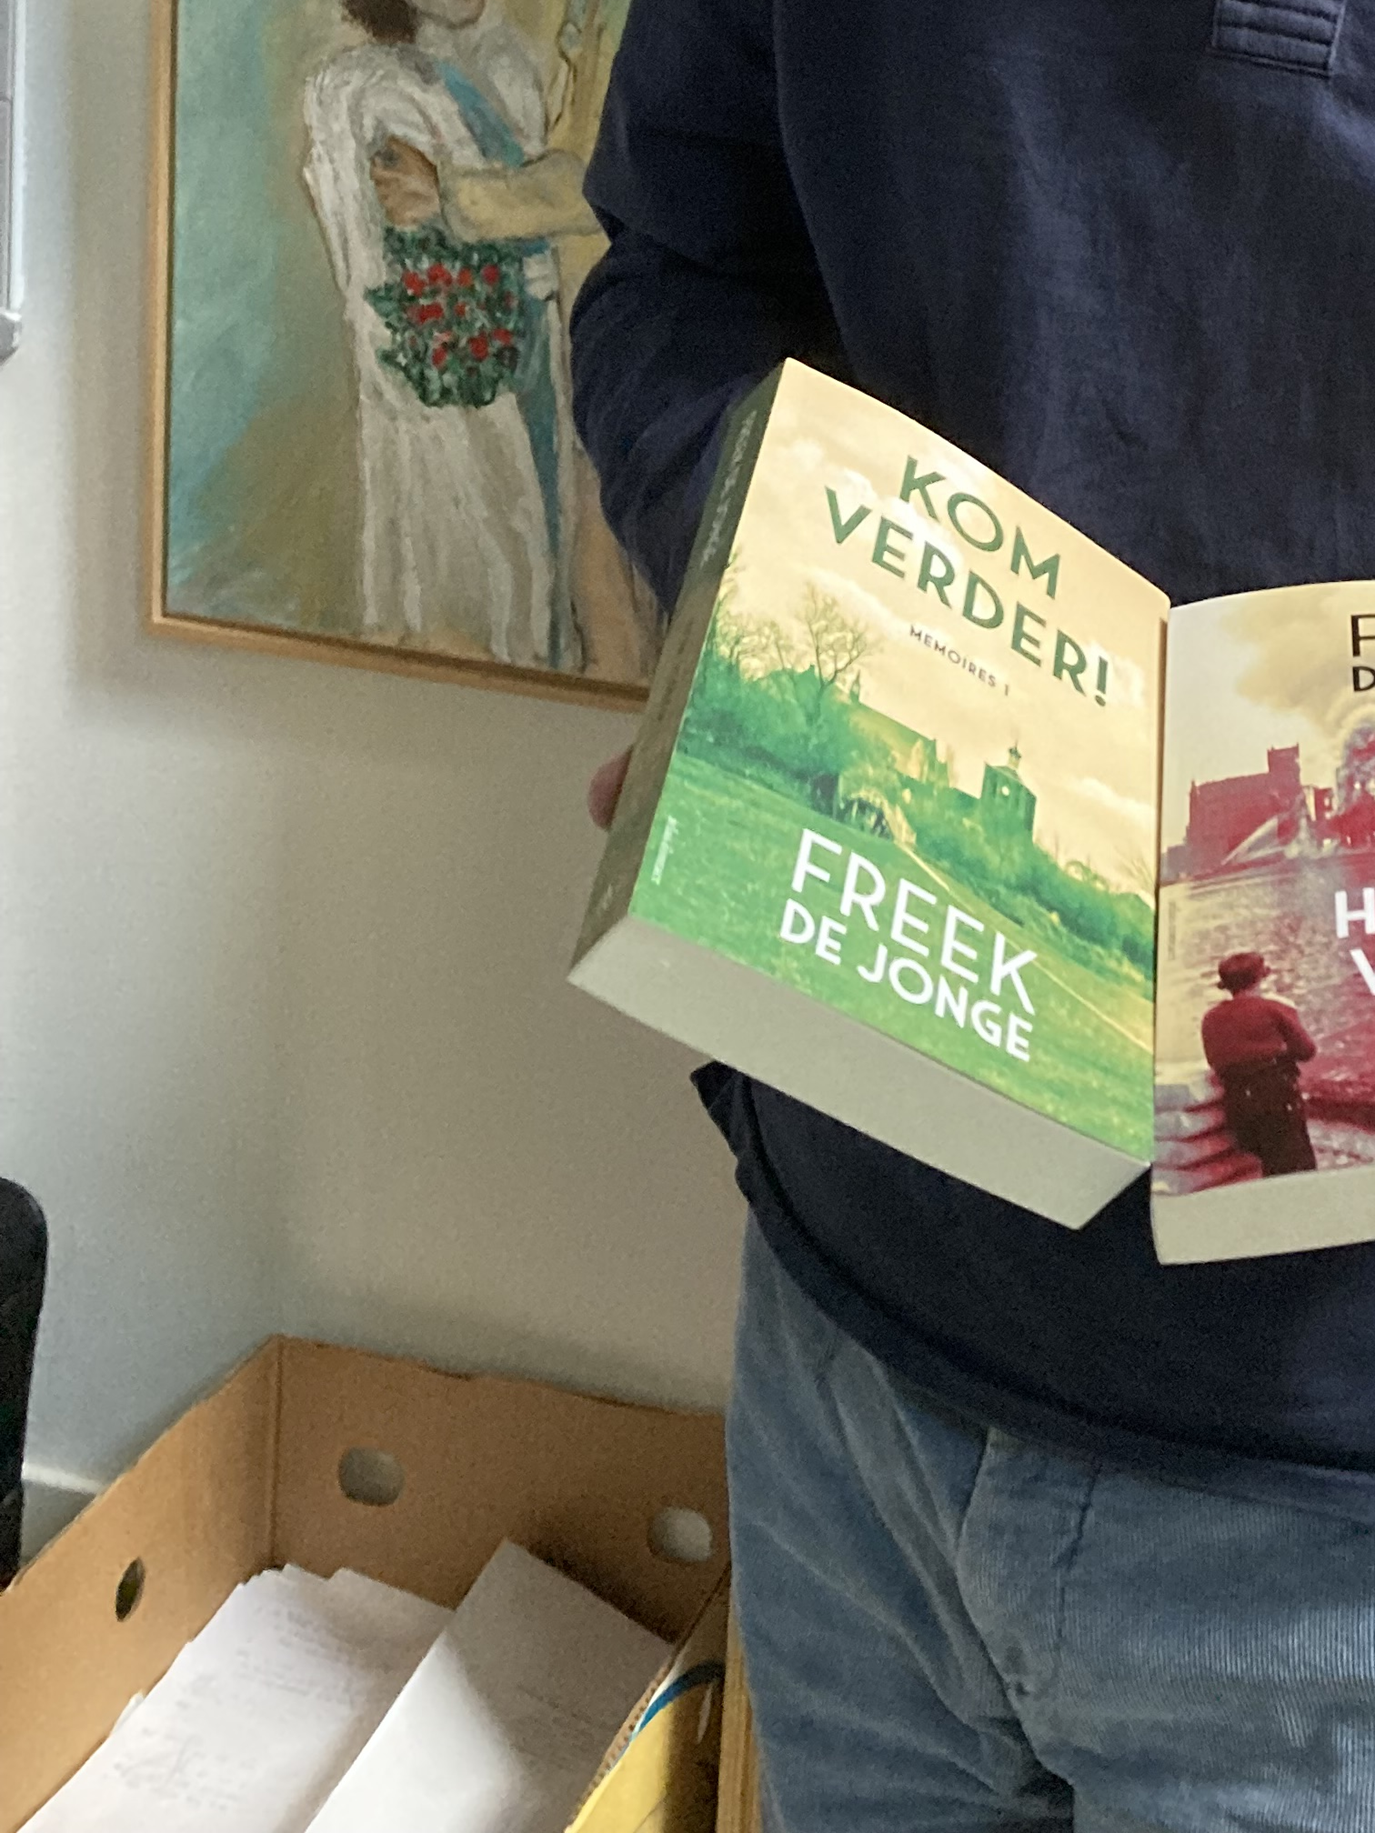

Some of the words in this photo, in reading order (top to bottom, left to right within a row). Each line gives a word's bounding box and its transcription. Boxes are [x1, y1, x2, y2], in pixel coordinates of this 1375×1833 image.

[823, 485, 1111, 709] VERDER!
[898, 454, 1061, 599] KOM
[907, 624, 997, 691] MEMOIRES
[779, 897, 849, 965] DE
[856, 943, 1033, 1063] JONGE
[790, 826, 1039, 1016] FREEK
